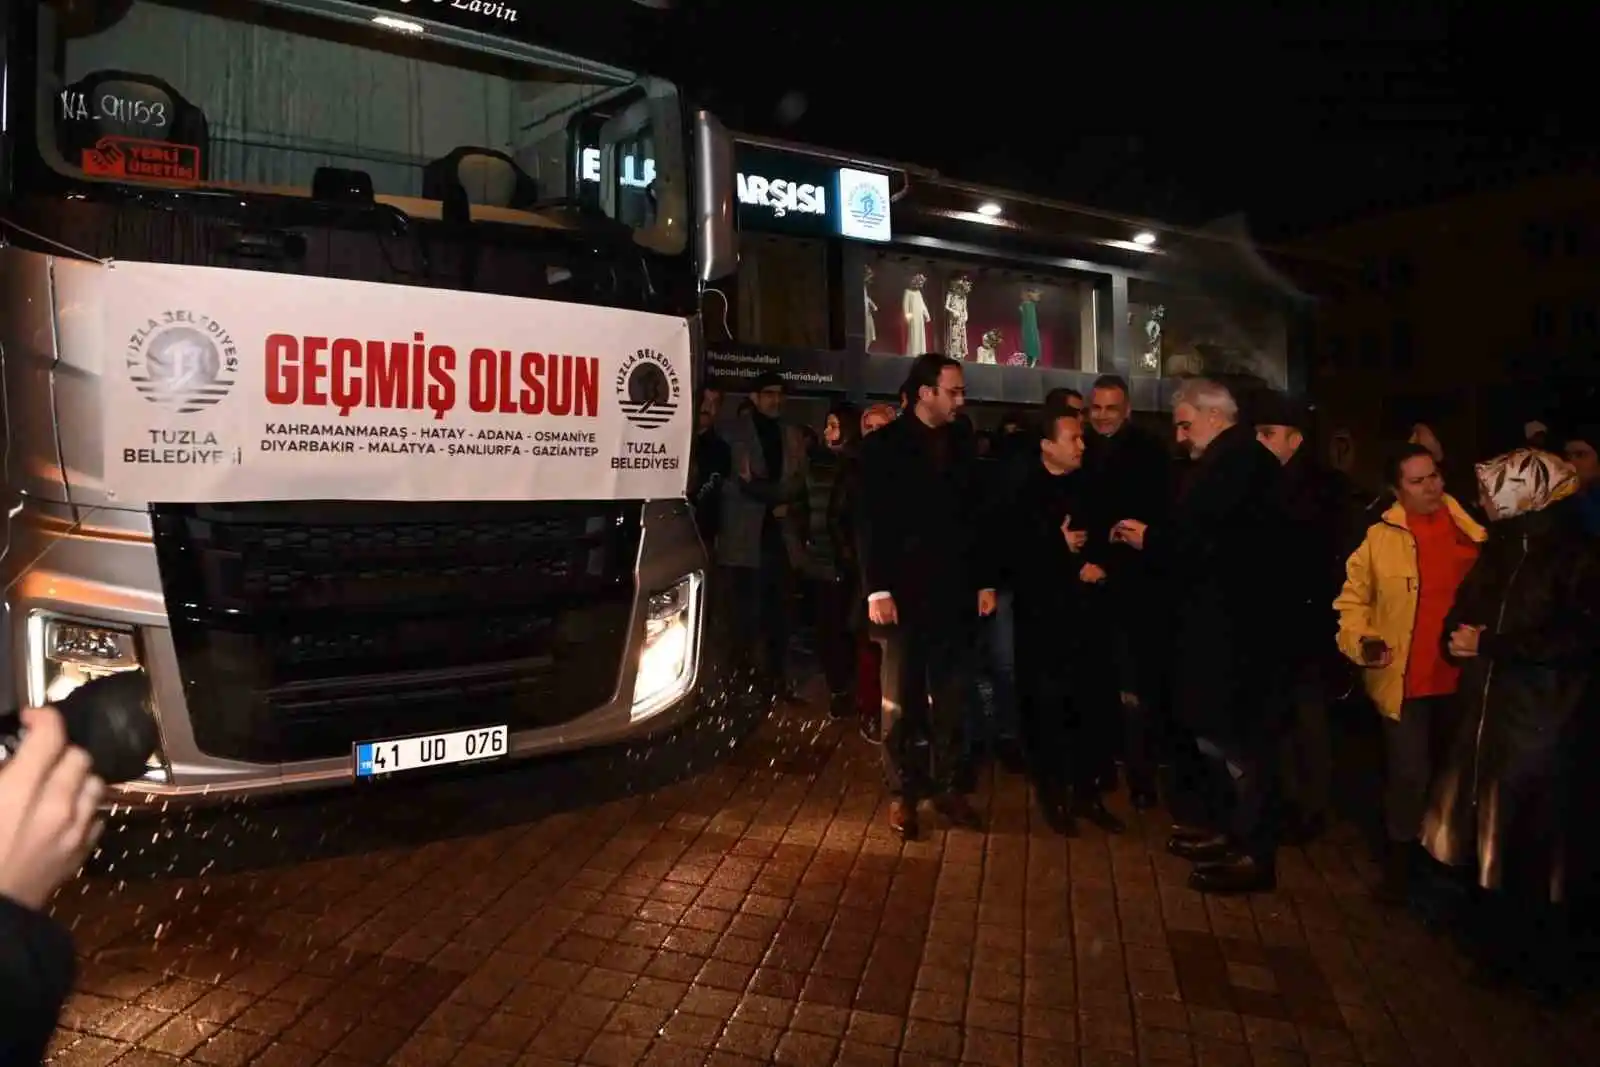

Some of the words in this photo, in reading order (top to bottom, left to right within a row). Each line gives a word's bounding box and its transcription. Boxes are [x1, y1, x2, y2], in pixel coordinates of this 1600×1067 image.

[265, 331, 456, 419] GEÇMİŞ
[469, 348, 599, 417] OLSUN
[616, 355, 637, 395] TUZLA
[148, 429, 217, 445] TUZLA
[265, 423, 408, 440] KAHRAMANMARAŞ
[420, 427, 466, 439] HATAY
[477, 429, 523, 441] ADANA
[534, 430, 596, 443] OSMANİYE
[123, 446, 242, 465] BELEDİYEİ
[368, 442, 436, 454] MALATYA
[447, 443, 521, 457] ŞANLIURFA
[532, 443, 599, 457] GAZİANTEP
[626, 442, 667, 454] TUZLA
[610, 455, 680, 469] BELEDİYESİ
[374, 743, 399, 768] 41
[420, 738, 446, 763] UD
[465, 730, 502, 756] 076
